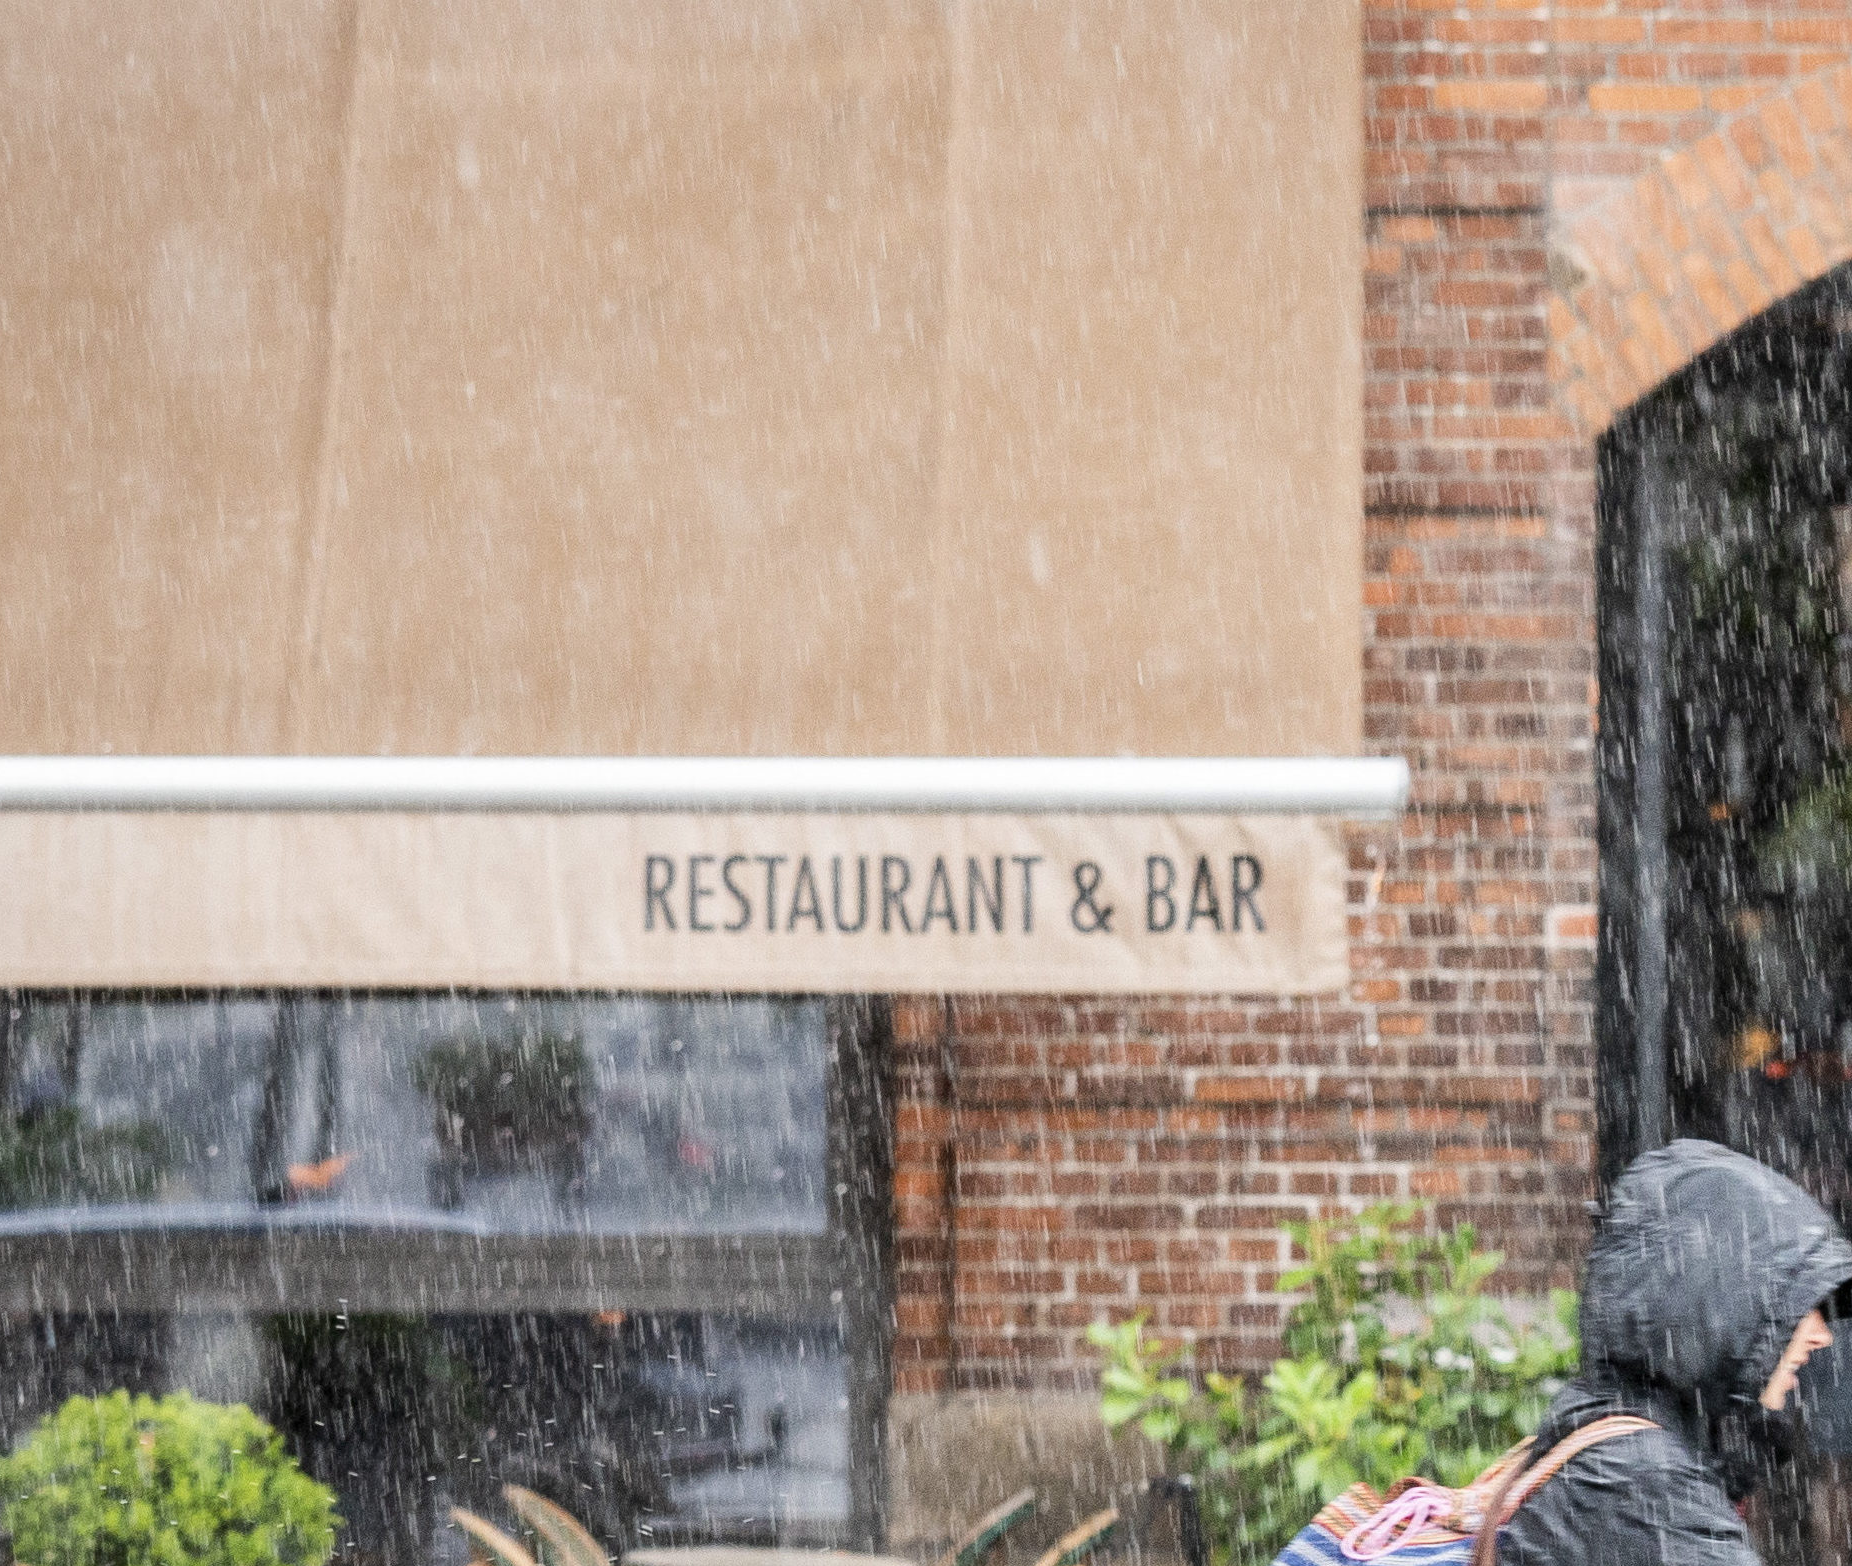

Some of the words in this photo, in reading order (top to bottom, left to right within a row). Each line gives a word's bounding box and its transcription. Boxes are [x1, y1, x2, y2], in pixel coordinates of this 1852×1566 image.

[643, 853, 1044, 934] RESTAURANT
[1068, 860, 1115, 934] &
[1145, 854, 1269, 934] BAR
